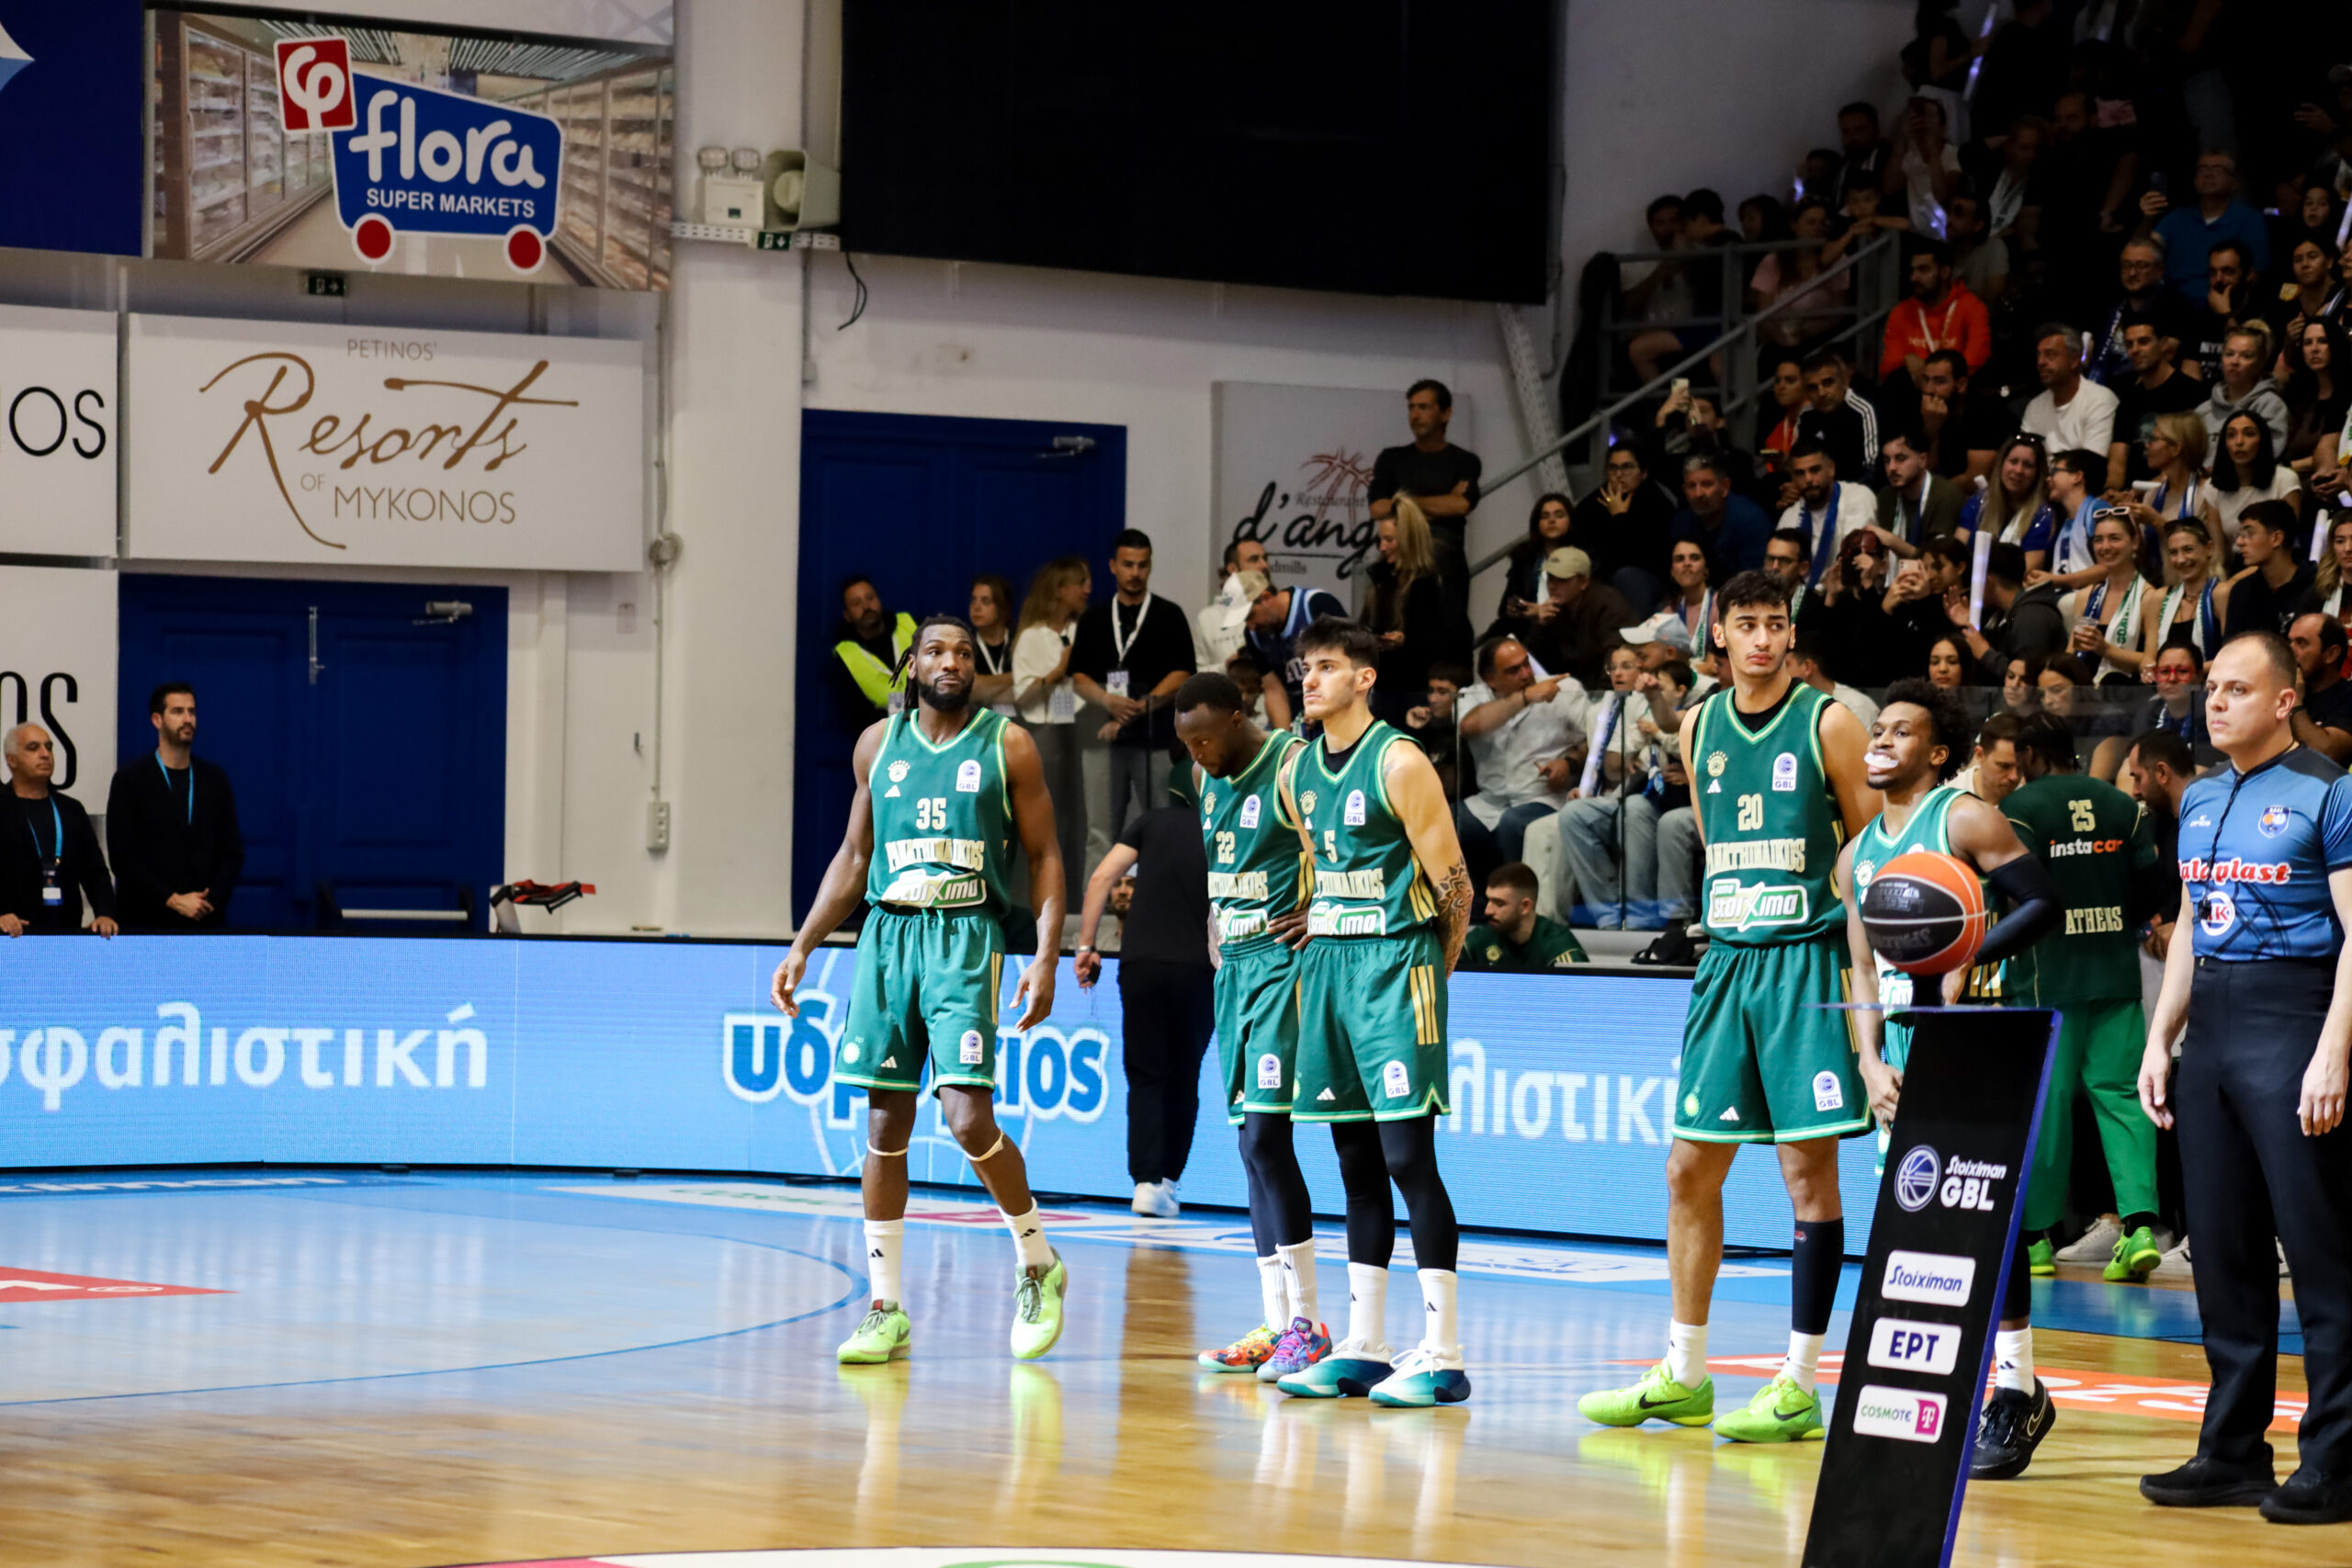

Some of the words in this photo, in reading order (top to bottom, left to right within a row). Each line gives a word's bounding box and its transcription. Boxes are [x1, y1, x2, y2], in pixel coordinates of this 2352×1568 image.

[349, 89, 546, 188] flora
[366, 187, 435, 211] SUPER
[439, 192, 536, 219] MARKETS
[346, 338, 437, 362] PETINOS'
[199, 353, 579, 549] Resorts
[300, 472, 326, 492] OF
[334, 485, 516, 525] MYKONOS
[1233, 480, 1381, 581] d'ang
[1270, 560, 1308, 574] dmills
[915, 797, 947, 830] 35
[1737, 794, 1764, 831] 20
[2068, 799, 2097, 832] 25
[1216, 830, 1236, 864] 22
[1324, 829, 1339, 863] 5
[2050, 838, 2123, 858] instacar
[0, 1001, 489, 1111] φαλιστική
[1945, 1155, 2007, 1180] Stoiximan
[1939, 1175, 1996, 1212] GBL
[1888, 1265, 1963, 1292] Stoiximan
